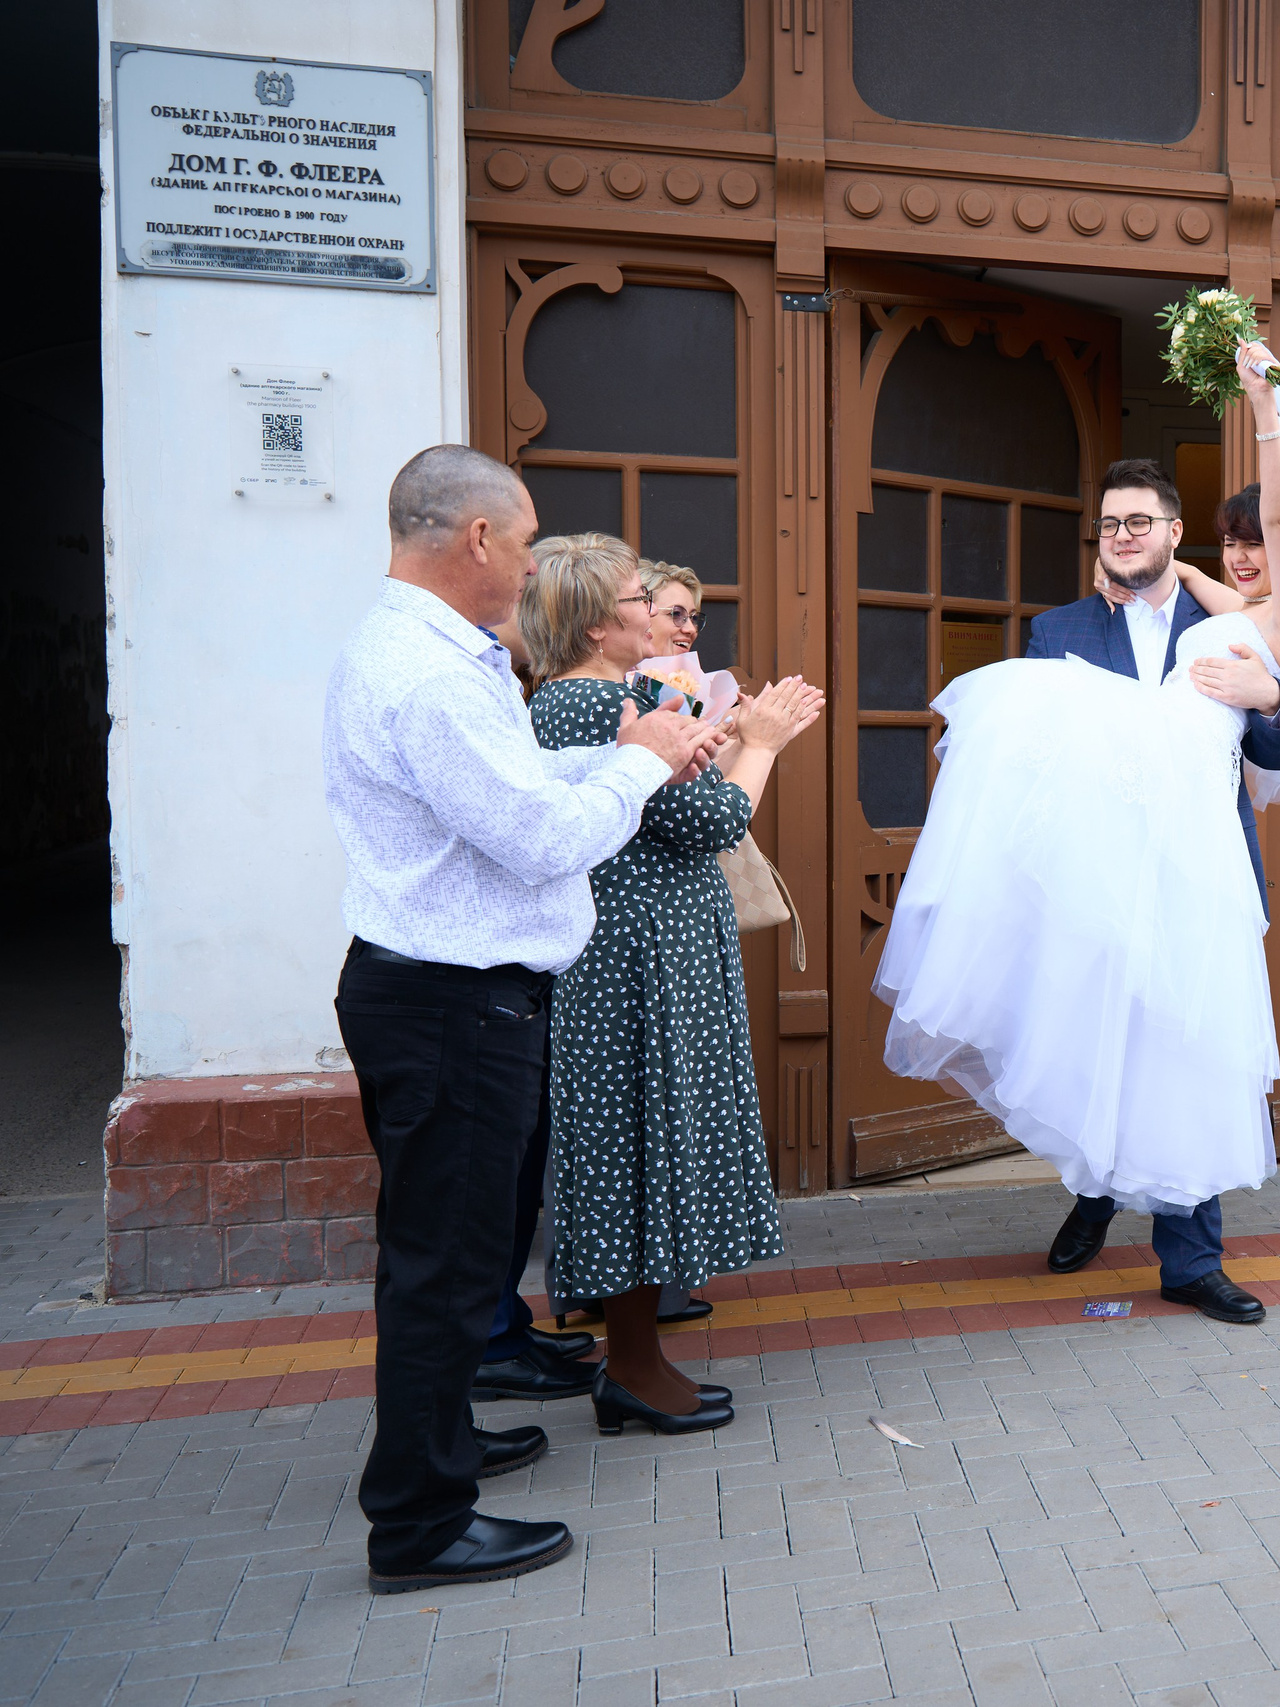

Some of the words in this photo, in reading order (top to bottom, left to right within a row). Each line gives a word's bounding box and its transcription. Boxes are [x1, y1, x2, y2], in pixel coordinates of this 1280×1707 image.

[320, 120, 396, 137] НАСЛЕДИЯ
[303, 134, 377, 151] ЗНАЧЕНИЯ
[168, 153, 227, 174] ДОМ
[233, 158, 251, 175] Г.
[258, 160, 283, 178] Ф.
[290, 162, 385, 185] ФЛЕЕРА
[325, 189, 402, 205] МАГАЗИНА)
[285, 210, 291, 219] В
[296, 211, 315, 220] 1900
[320, 212, 348, 223] ГОДУ
[146, 222, 222, 238] ПОДЛЕЖИТ
